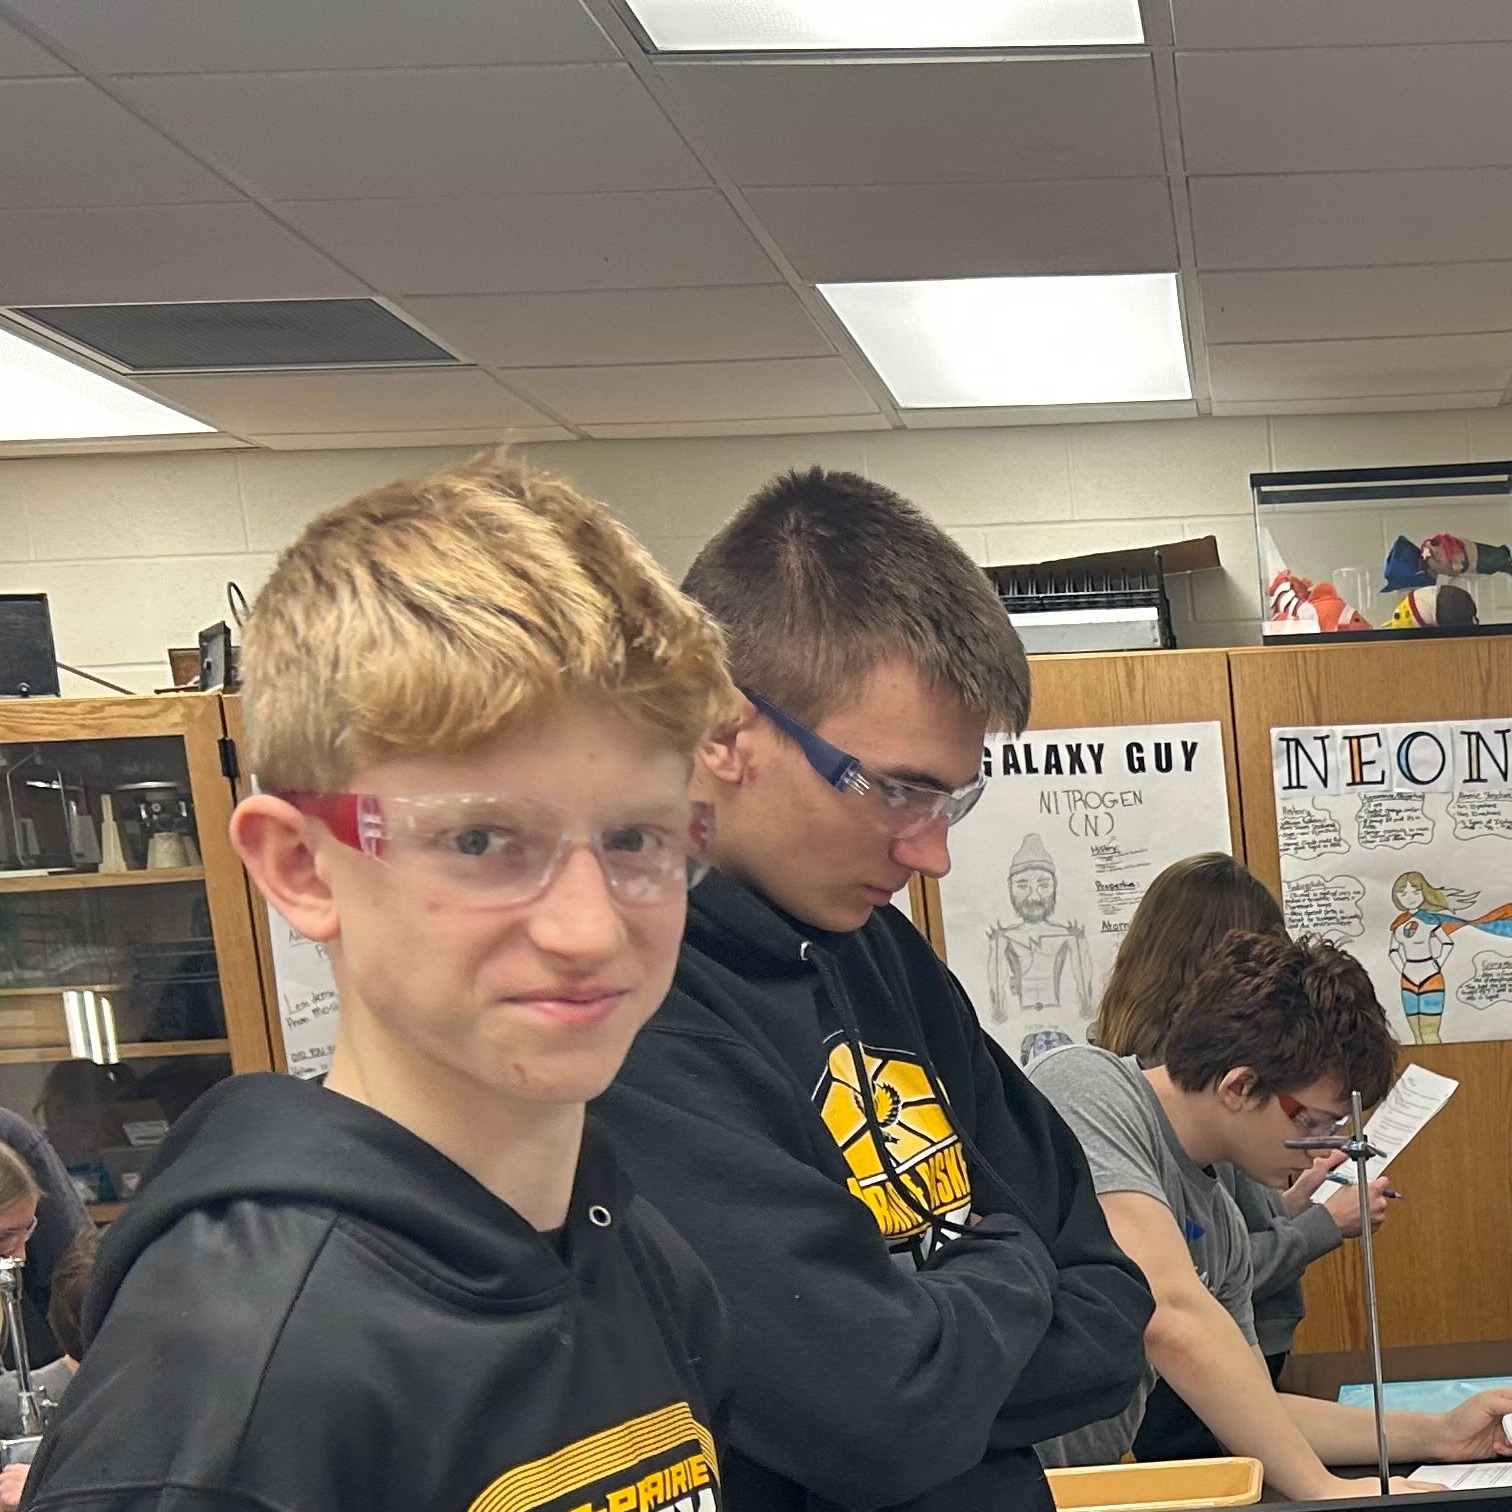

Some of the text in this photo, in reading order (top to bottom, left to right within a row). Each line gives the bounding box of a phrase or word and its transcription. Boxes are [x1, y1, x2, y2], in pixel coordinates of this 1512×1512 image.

[1126, 740, 1199, 774] GUY
[1280, 728, 1511, 791] NEON
[1039, 789, 1143, 814] NITROGEN
[1068, 812, 1115, 837] (N)
